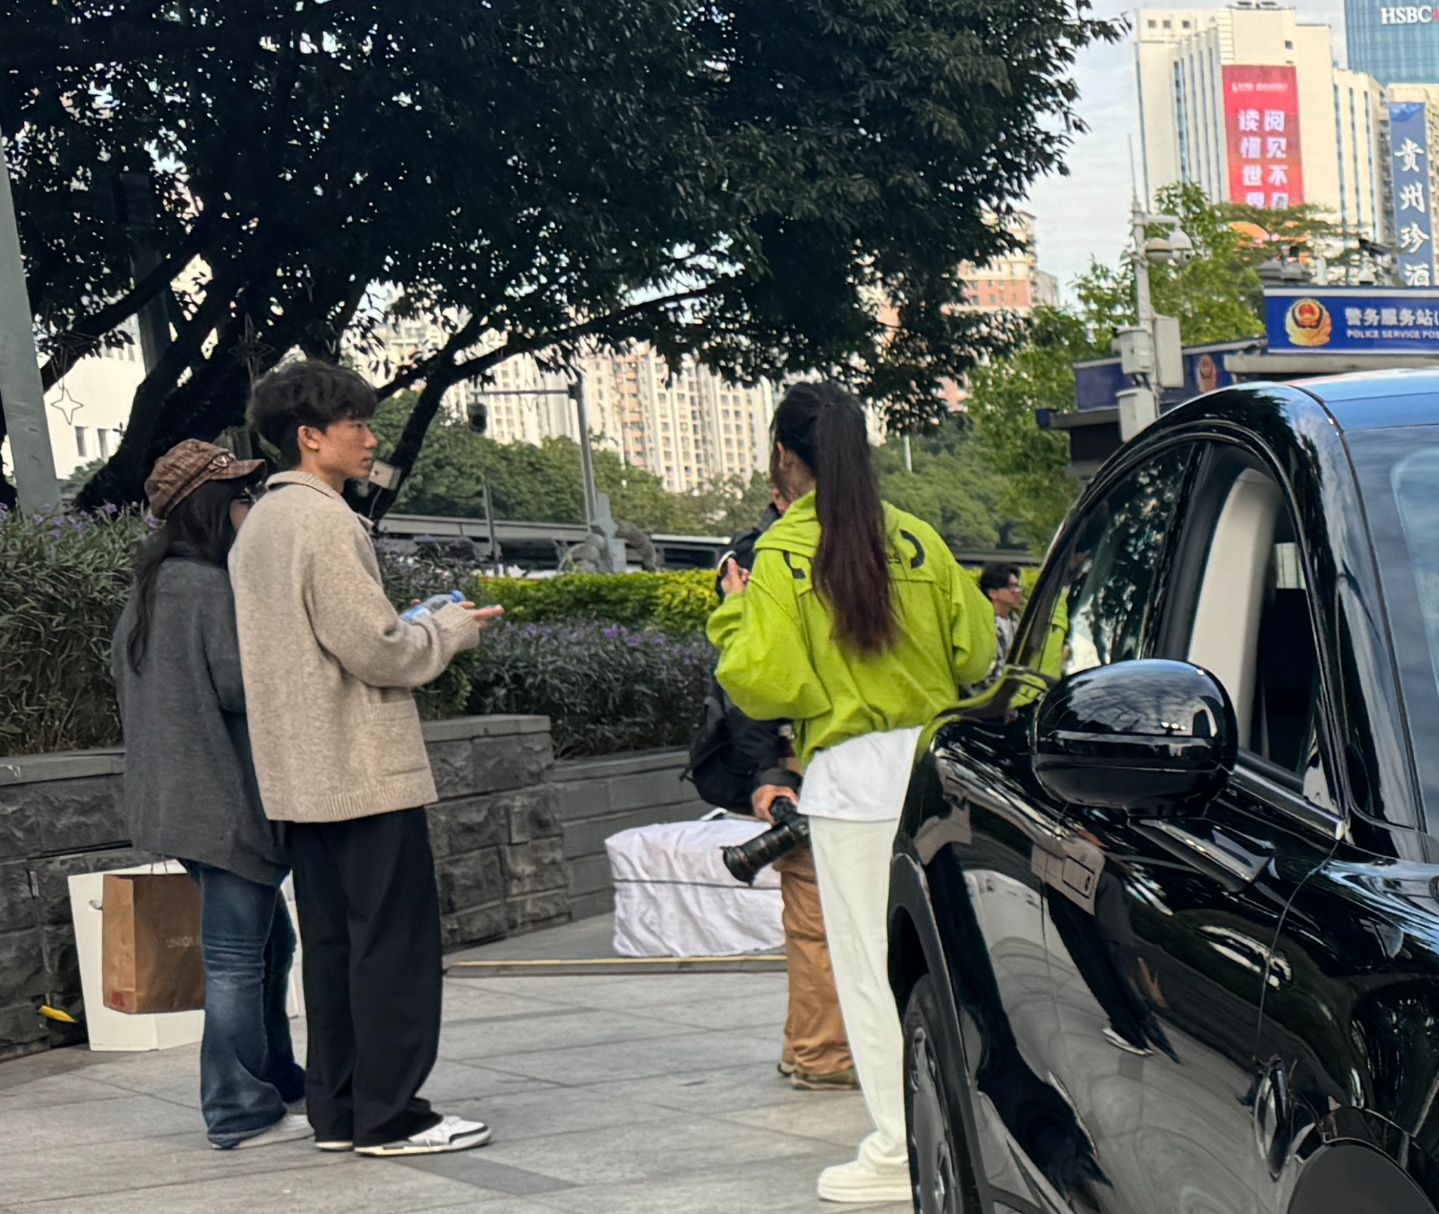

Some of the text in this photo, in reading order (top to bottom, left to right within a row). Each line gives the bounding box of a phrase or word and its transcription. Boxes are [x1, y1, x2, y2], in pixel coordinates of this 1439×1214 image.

[1381, 6, 1432, 24] HSBC
[1346, 329, 1379, 338] POLICE
[1381, 329, 1420, 338] SERVICE
